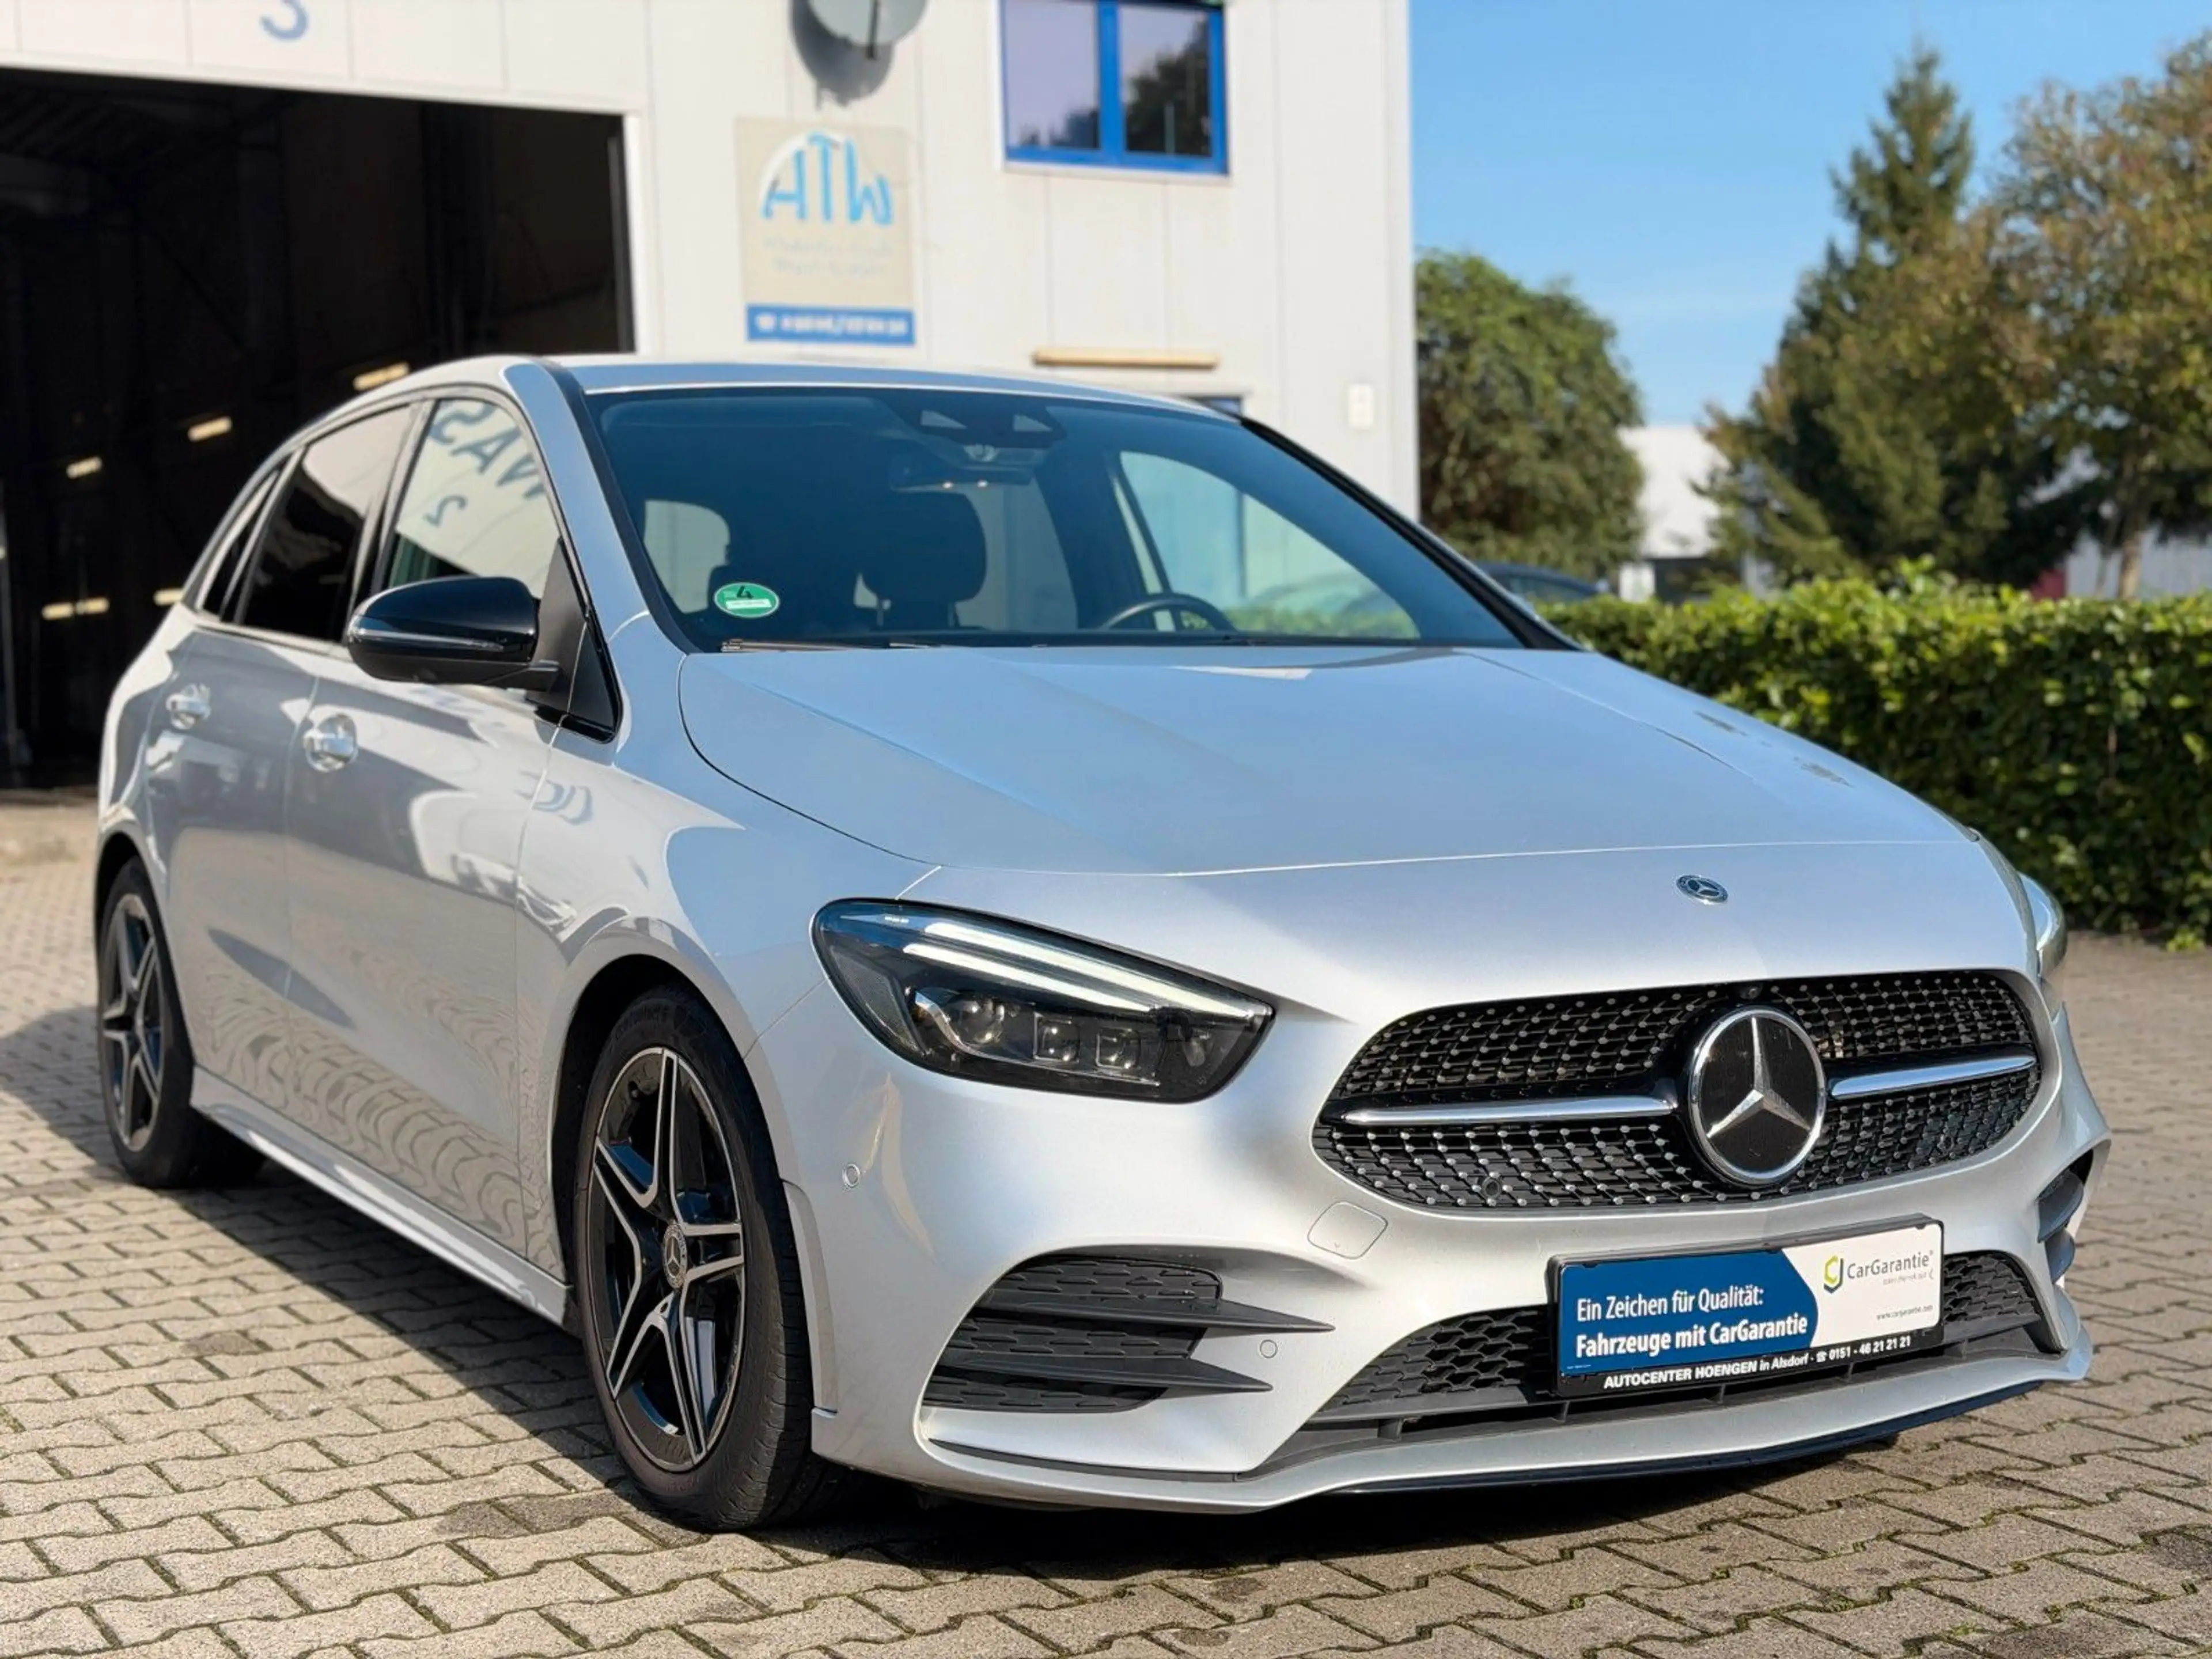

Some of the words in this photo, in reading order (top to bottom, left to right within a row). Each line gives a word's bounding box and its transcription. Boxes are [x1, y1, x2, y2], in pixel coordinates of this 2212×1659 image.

[736, 585, 754, 599] 4
[1847, 1251, 1930, 1279] CarGarantie
[1577, 1298, 1602, 1322] Ein
[1605, 1293, 1668, 1319] Zeichen
[1672, 1289, 1696, 1314] für
[1698, 1284, 1764, 1313] Qualität:
[1575, 1332, 1671, 1358] Fahrzeuge
[1675, 1324, 1707, 1349] mit
[1709, 1312, 1808, 1345] CarGarantie
[1603, 1367, 1692, 1390] AUTOCENTER
[1695, 1359, 1758, 1380] HOENGEN
[1759, 1358, 1770, 1371] in
[1771, 1353, 1809, 1370] Alsdorf
[1829, 1346, 1851, 1361] 0151
[1859, 1342, 1872, 1355] 46
[1873, 1340, 1884, 1353] 21
[1886, 1338, 1897, 1350] 21
[1899, 1335, 1911, 1348] 21
